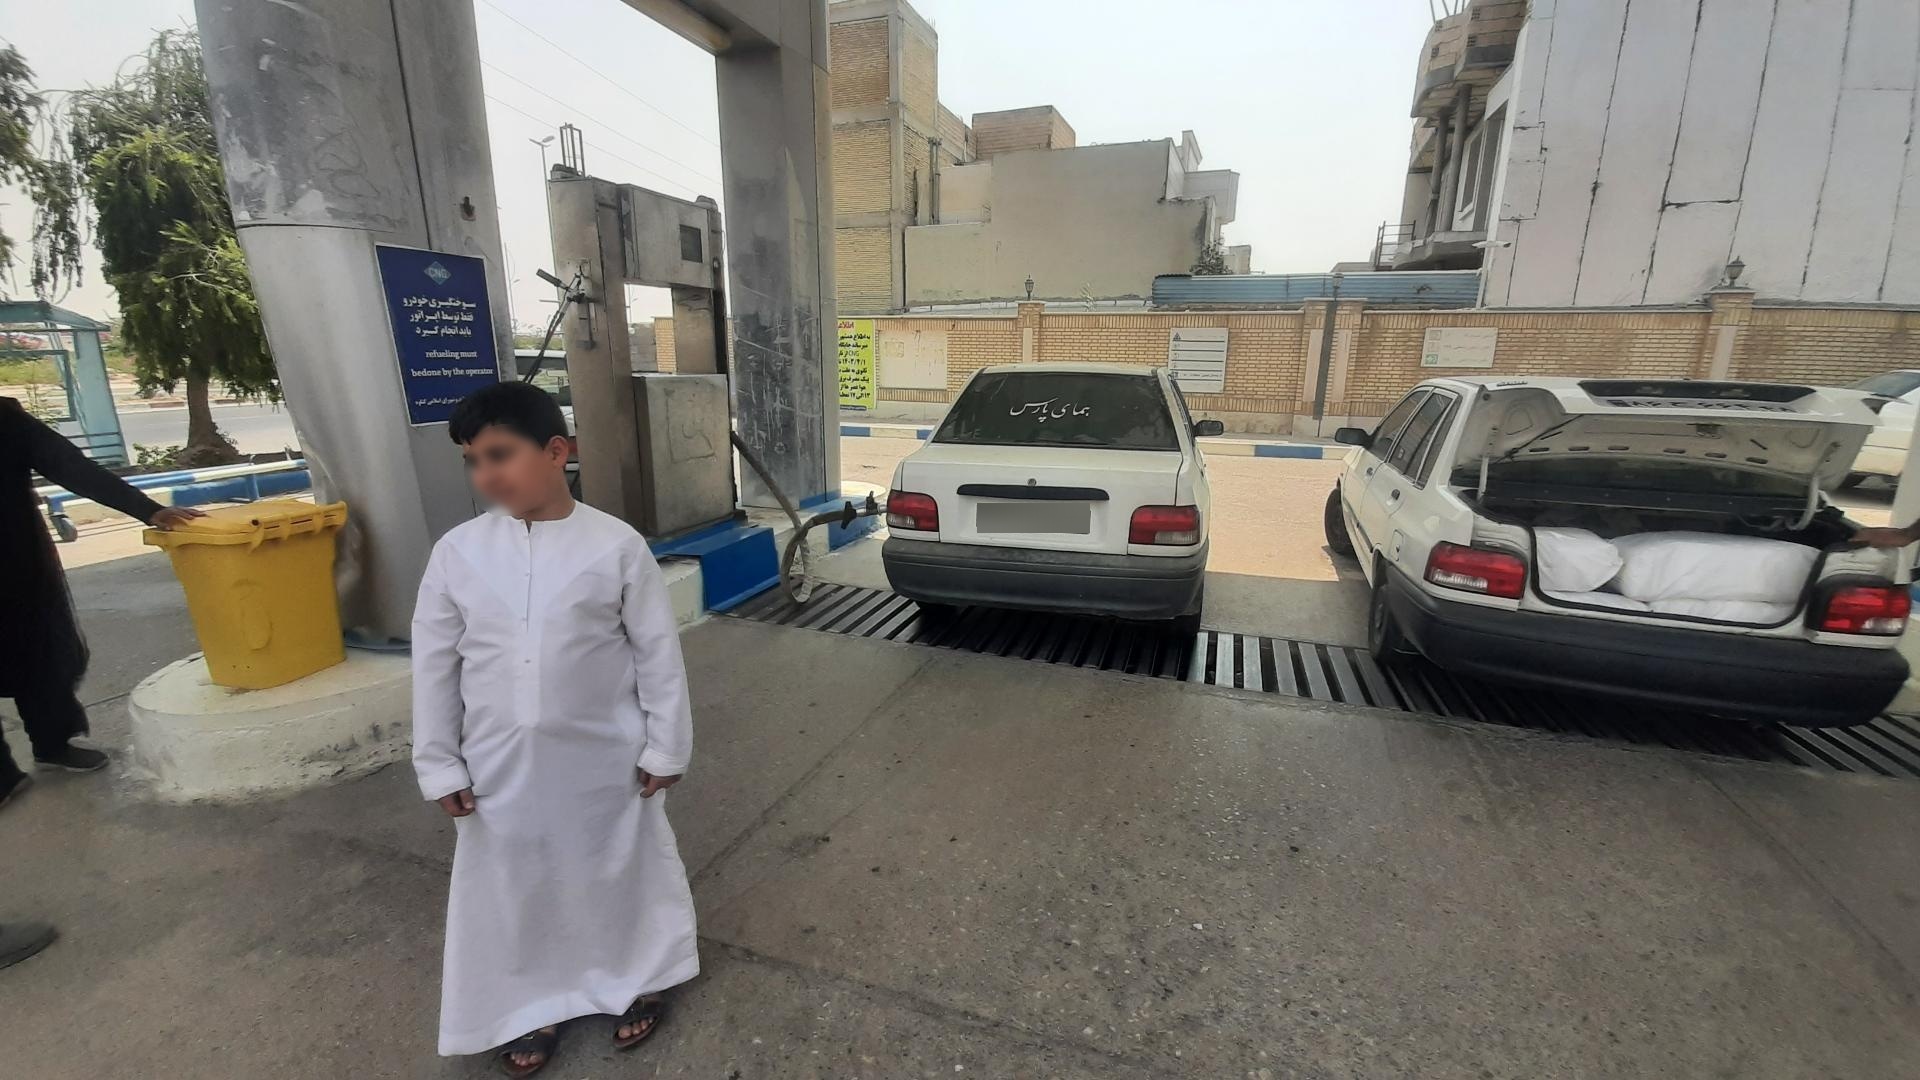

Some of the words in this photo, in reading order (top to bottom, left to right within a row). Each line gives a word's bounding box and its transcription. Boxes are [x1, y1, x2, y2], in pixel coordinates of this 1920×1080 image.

[428, 267, 449, 279] CNG
[402, 295, 428, 307] خودرو
[441, 310, 460, 323] توسط
[460, 312, 474, 322] فقط
[440, 325, 459, 337] انجام
[458, 326, 472, 337] باید
[425, 349, 460, 360] refueling
[442, 368, 453, 377] by
[453, 367, 465, 375] the
[465, 368, 494, 377] operator
[1009, 397, 1059, 423] پارس
